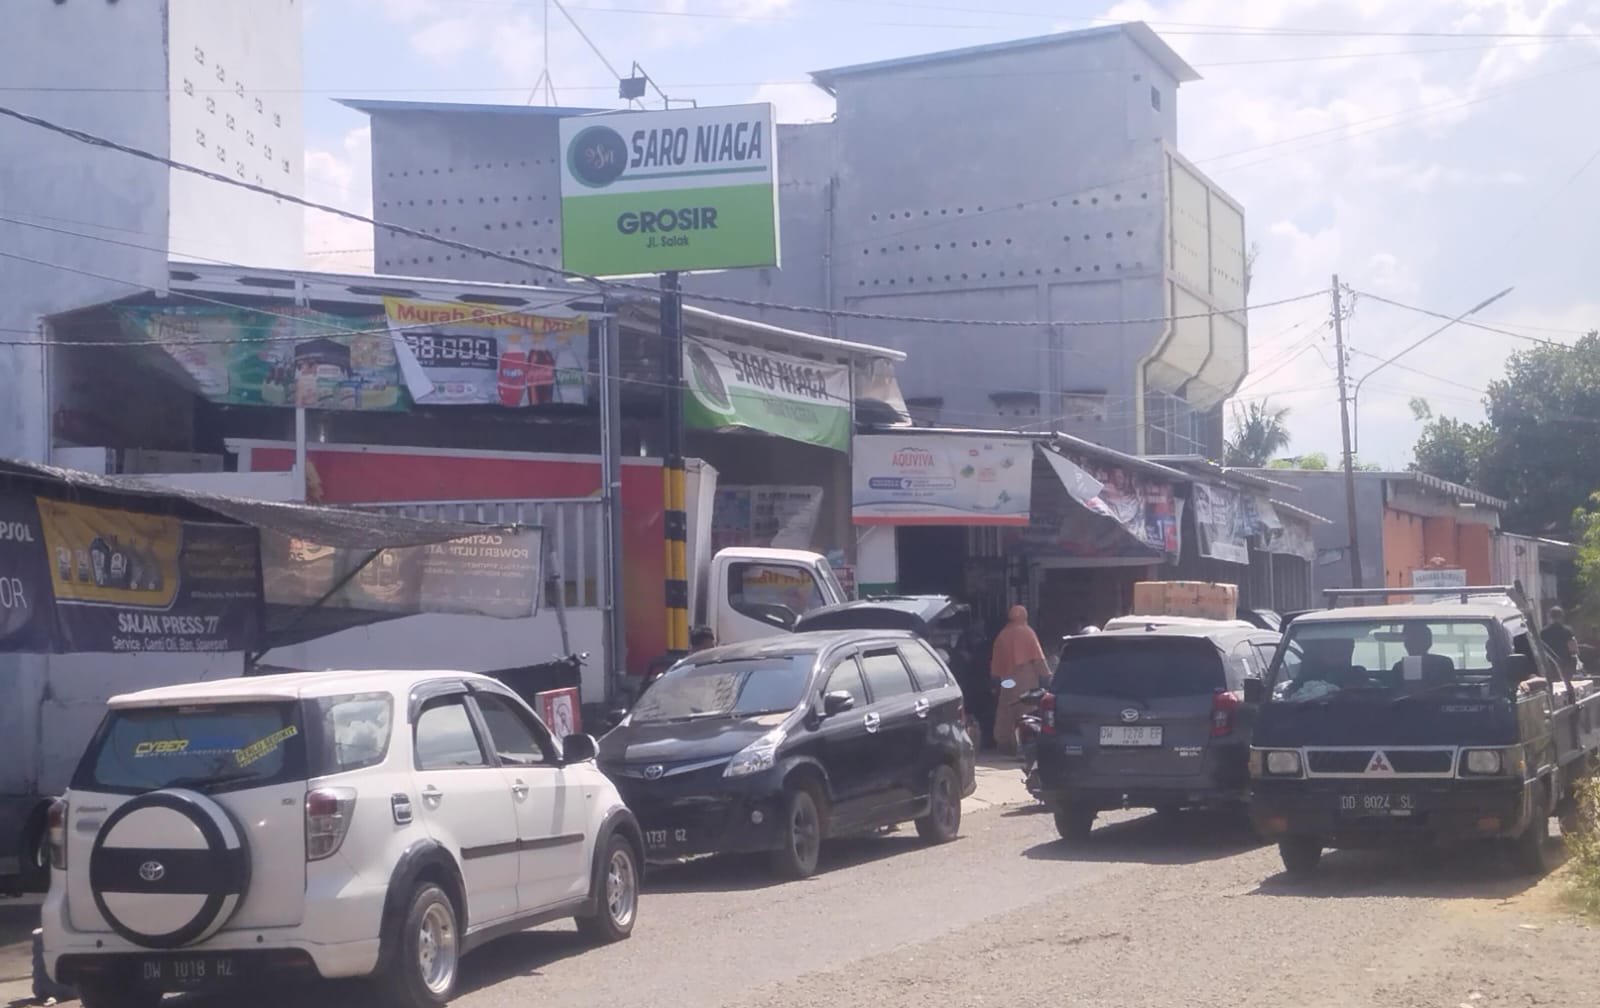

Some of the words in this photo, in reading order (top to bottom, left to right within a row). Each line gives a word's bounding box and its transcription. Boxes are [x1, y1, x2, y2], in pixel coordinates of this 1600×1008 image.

[630, 127, 689, 169] SARO
[694, 121, 762, 164] NIAGA
[616, 207, 719, 235] GROSIR
[661, 235, 690, 248] Salak
[397, 303, 465, 324] Murah
[728, 351, 775, 390] SARO
[777, 361, 829, 401] NIAGA
[118, 612, 162, 634] SALAK
[162, 615, 205, 635] PRESS
[135, 739, 190, 755] CYBER
[1363, 795, 1391, 809] 8024
[1400, 795, 1415, 809] SL
[143, 961, 161, 979] DW
[173, 959, 206, 978] 1018
[217, 959, 233, 976] HZ
